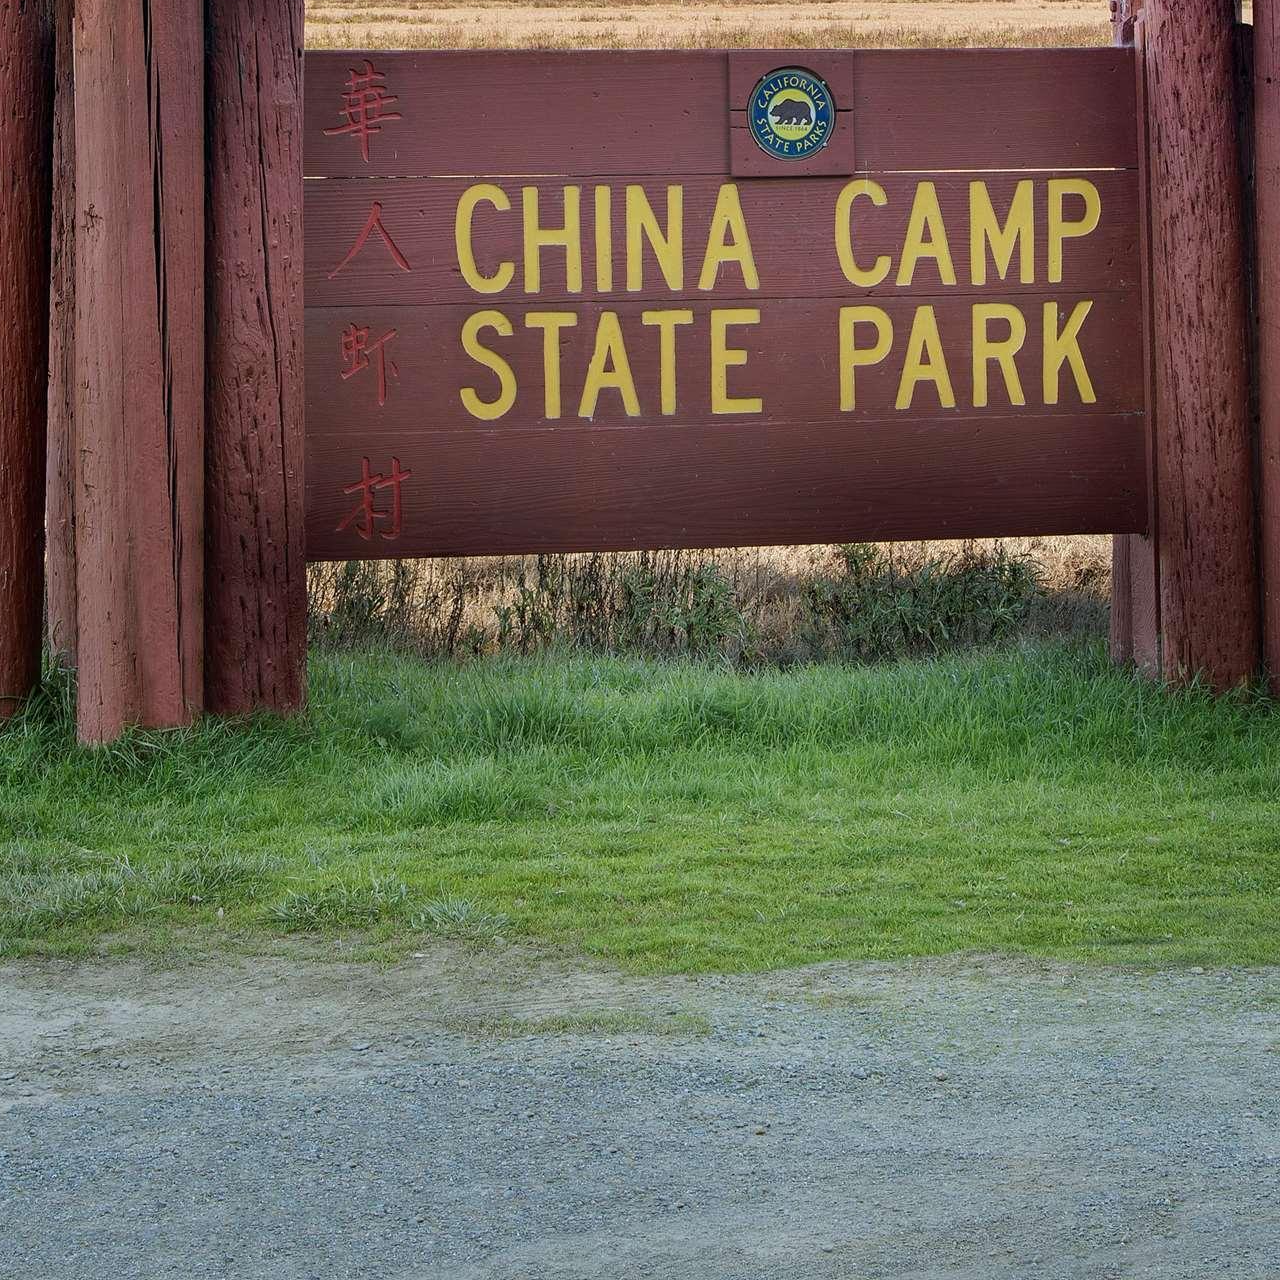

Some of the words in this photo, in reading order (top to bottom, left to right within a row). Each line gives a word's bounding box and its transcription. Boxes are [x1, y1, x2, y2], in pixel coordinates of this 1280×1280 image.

[758, 76, 826, 110] CALIFORNIA
[757, 118, 790, 152] STATE
[796, 120, 827, 152] PARKS
[455, 183, 760, 294] CHINA
[835, 178, 1102, 287] CAMP
[460, 308, 763, 421] STATE
[839, 300, 1097, 412] PARK
